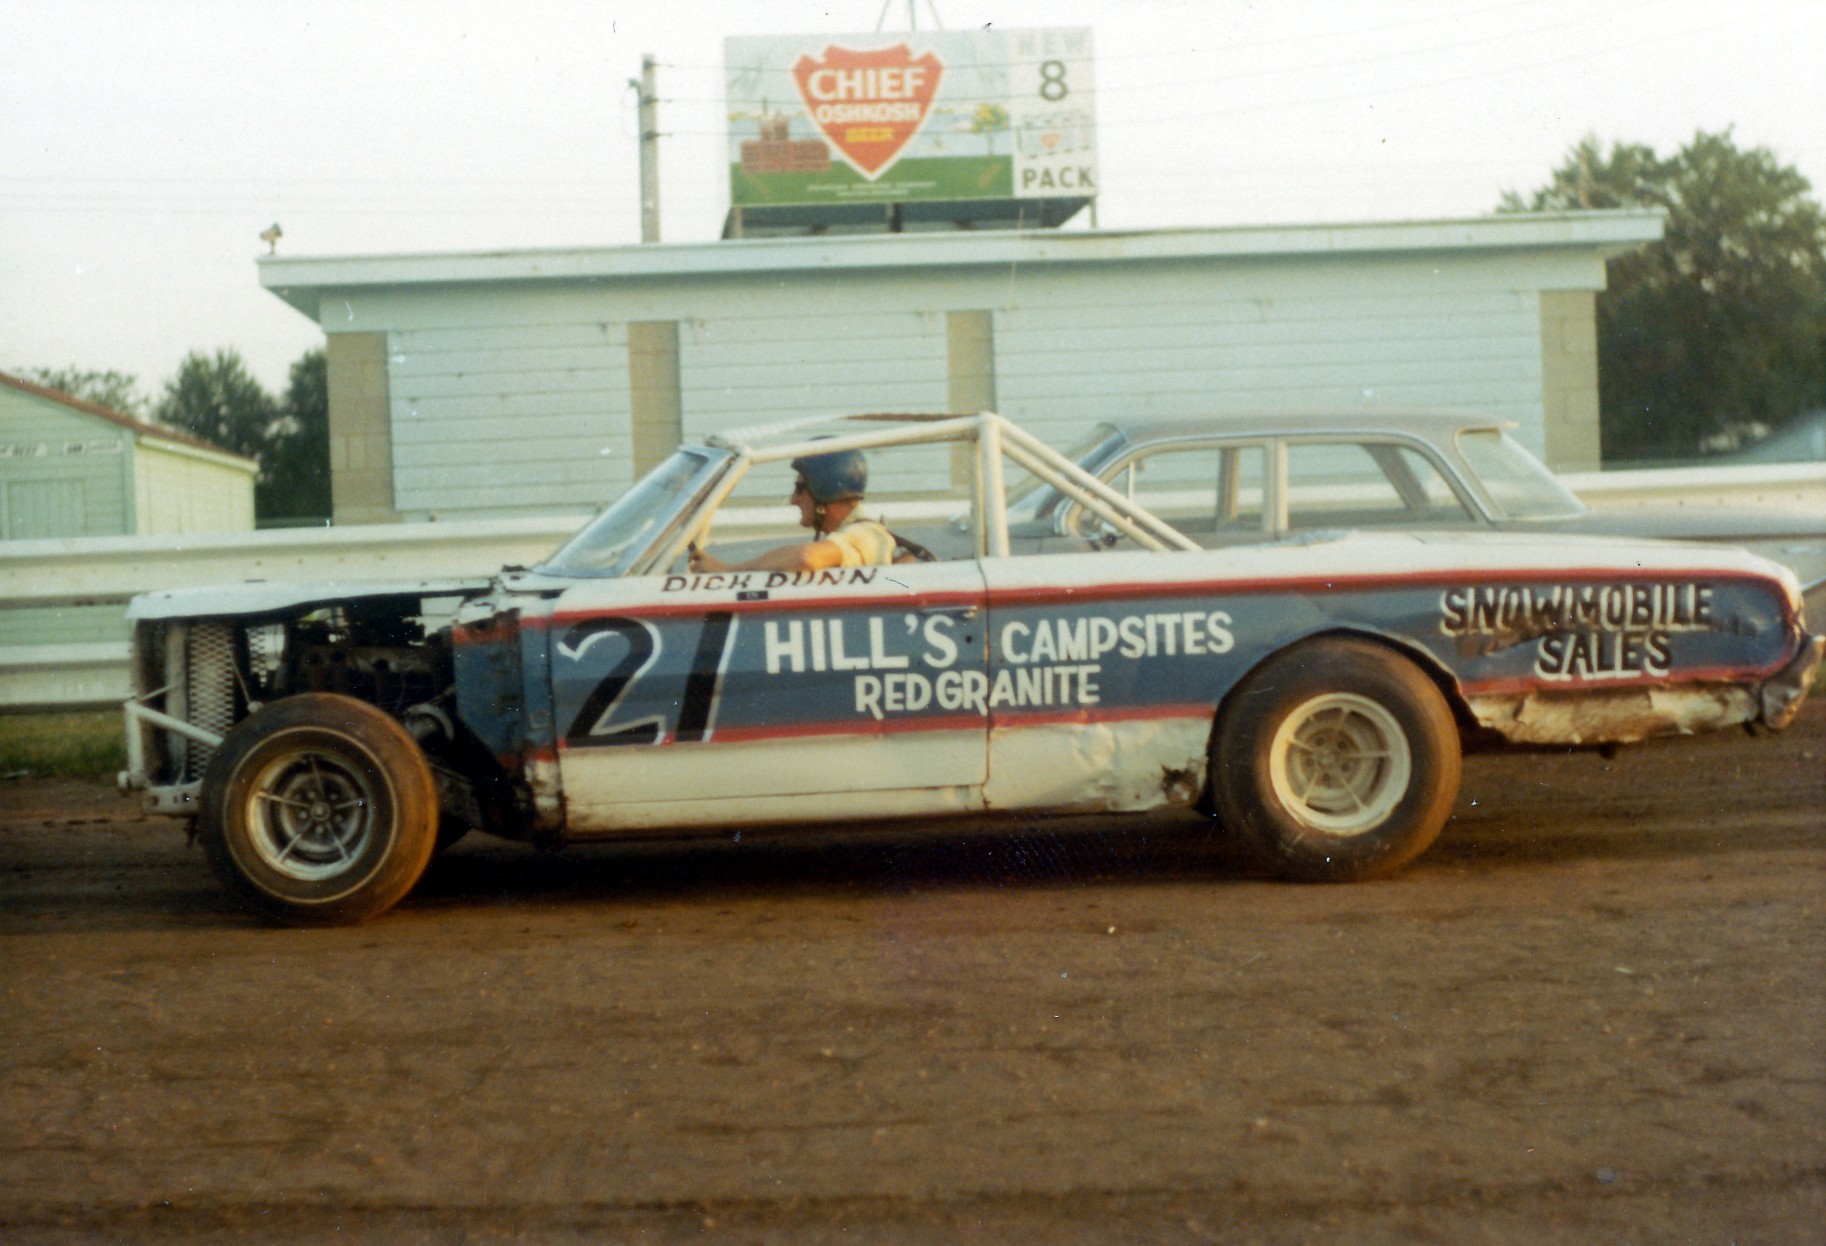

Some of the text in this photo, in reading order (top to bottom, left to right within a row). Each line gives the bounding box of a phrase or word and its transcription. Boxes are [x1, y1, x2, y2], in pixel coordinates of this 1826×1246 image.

[809, 68, 924, 100] CHIEF
[1040, 60, 1067, 101] 8
[1022, 166, 1094, 188] PACK
[662, 575, 751, 591] DICK
[1440, 584, 1714, 636] SNOWMOBILE
[766, 612, 1234, 673] HILL'S CAMPSITES
[1535, 632, 1673, 681] SALES
[557, 611, 740, 746] 21
